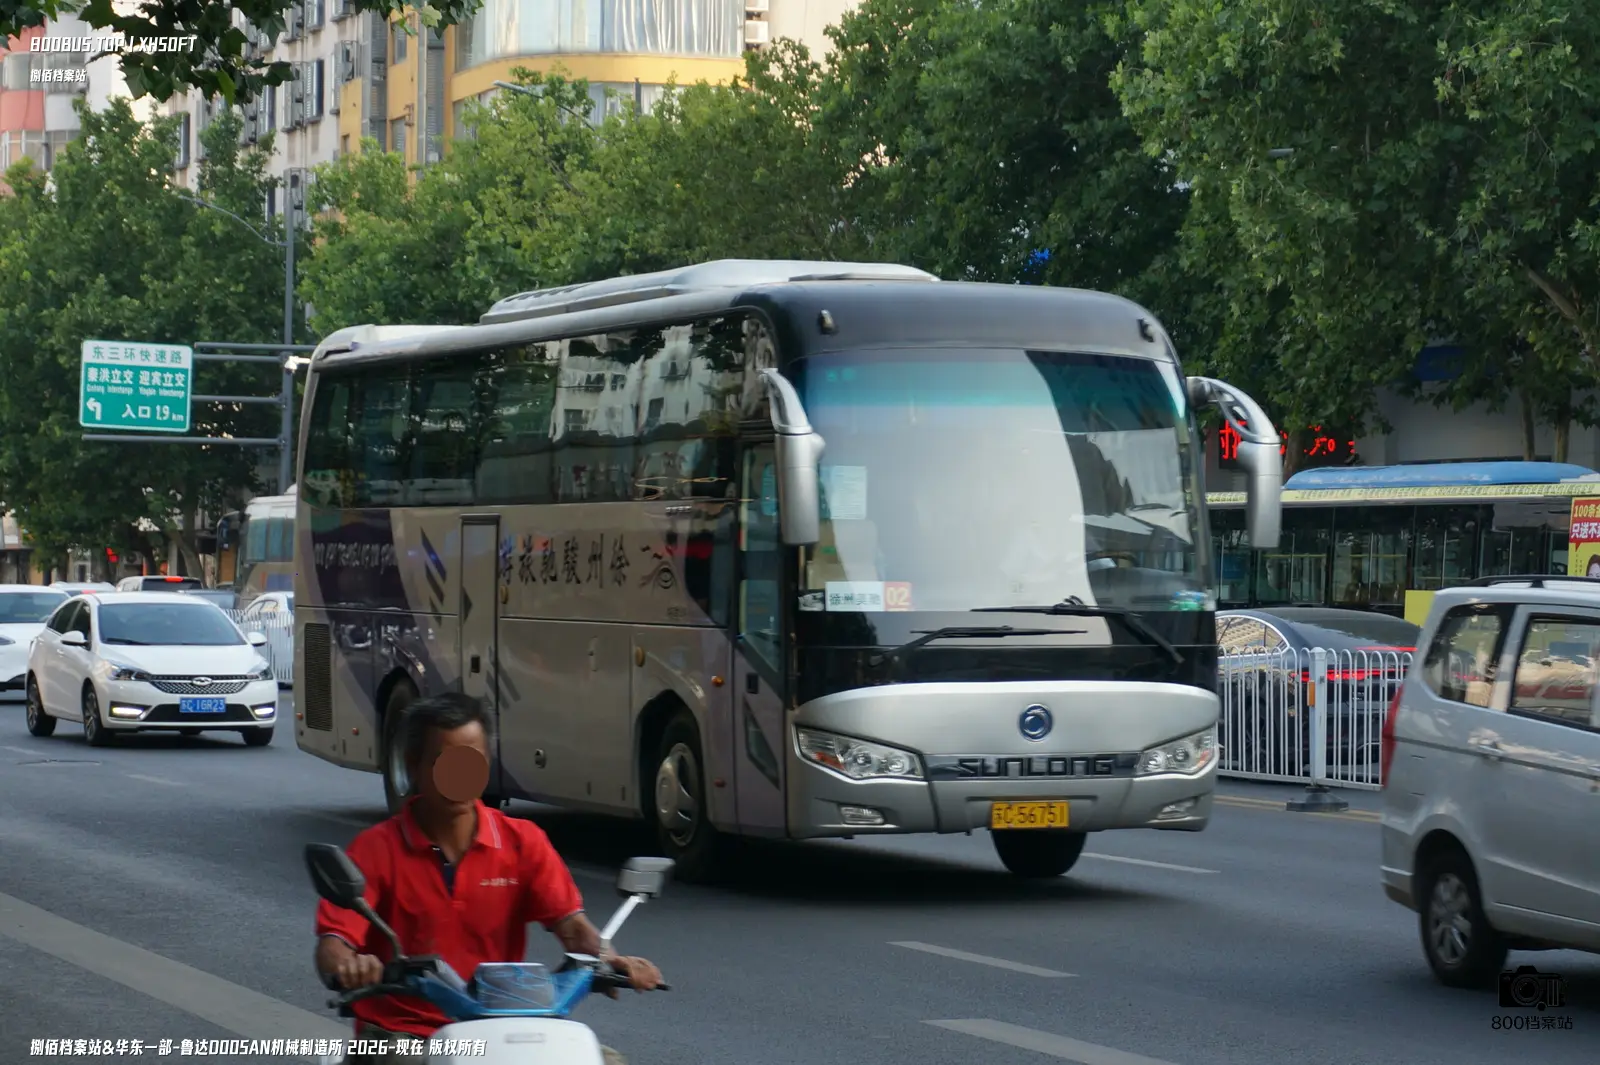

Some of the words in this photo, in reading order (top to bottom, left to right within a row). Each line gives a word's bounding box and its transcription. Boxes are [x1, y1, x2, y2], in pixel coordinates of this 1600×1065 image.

[92, 346, 182, 363] 东三环快速路
[139, 371, 185, 387] 迎宾立交
[122, 404, 151, 418] 入口
[172, 413, 184, 421] km
[887, 587, 909, 605] 02
[957, 757, 1114, 777] SUNLONG
